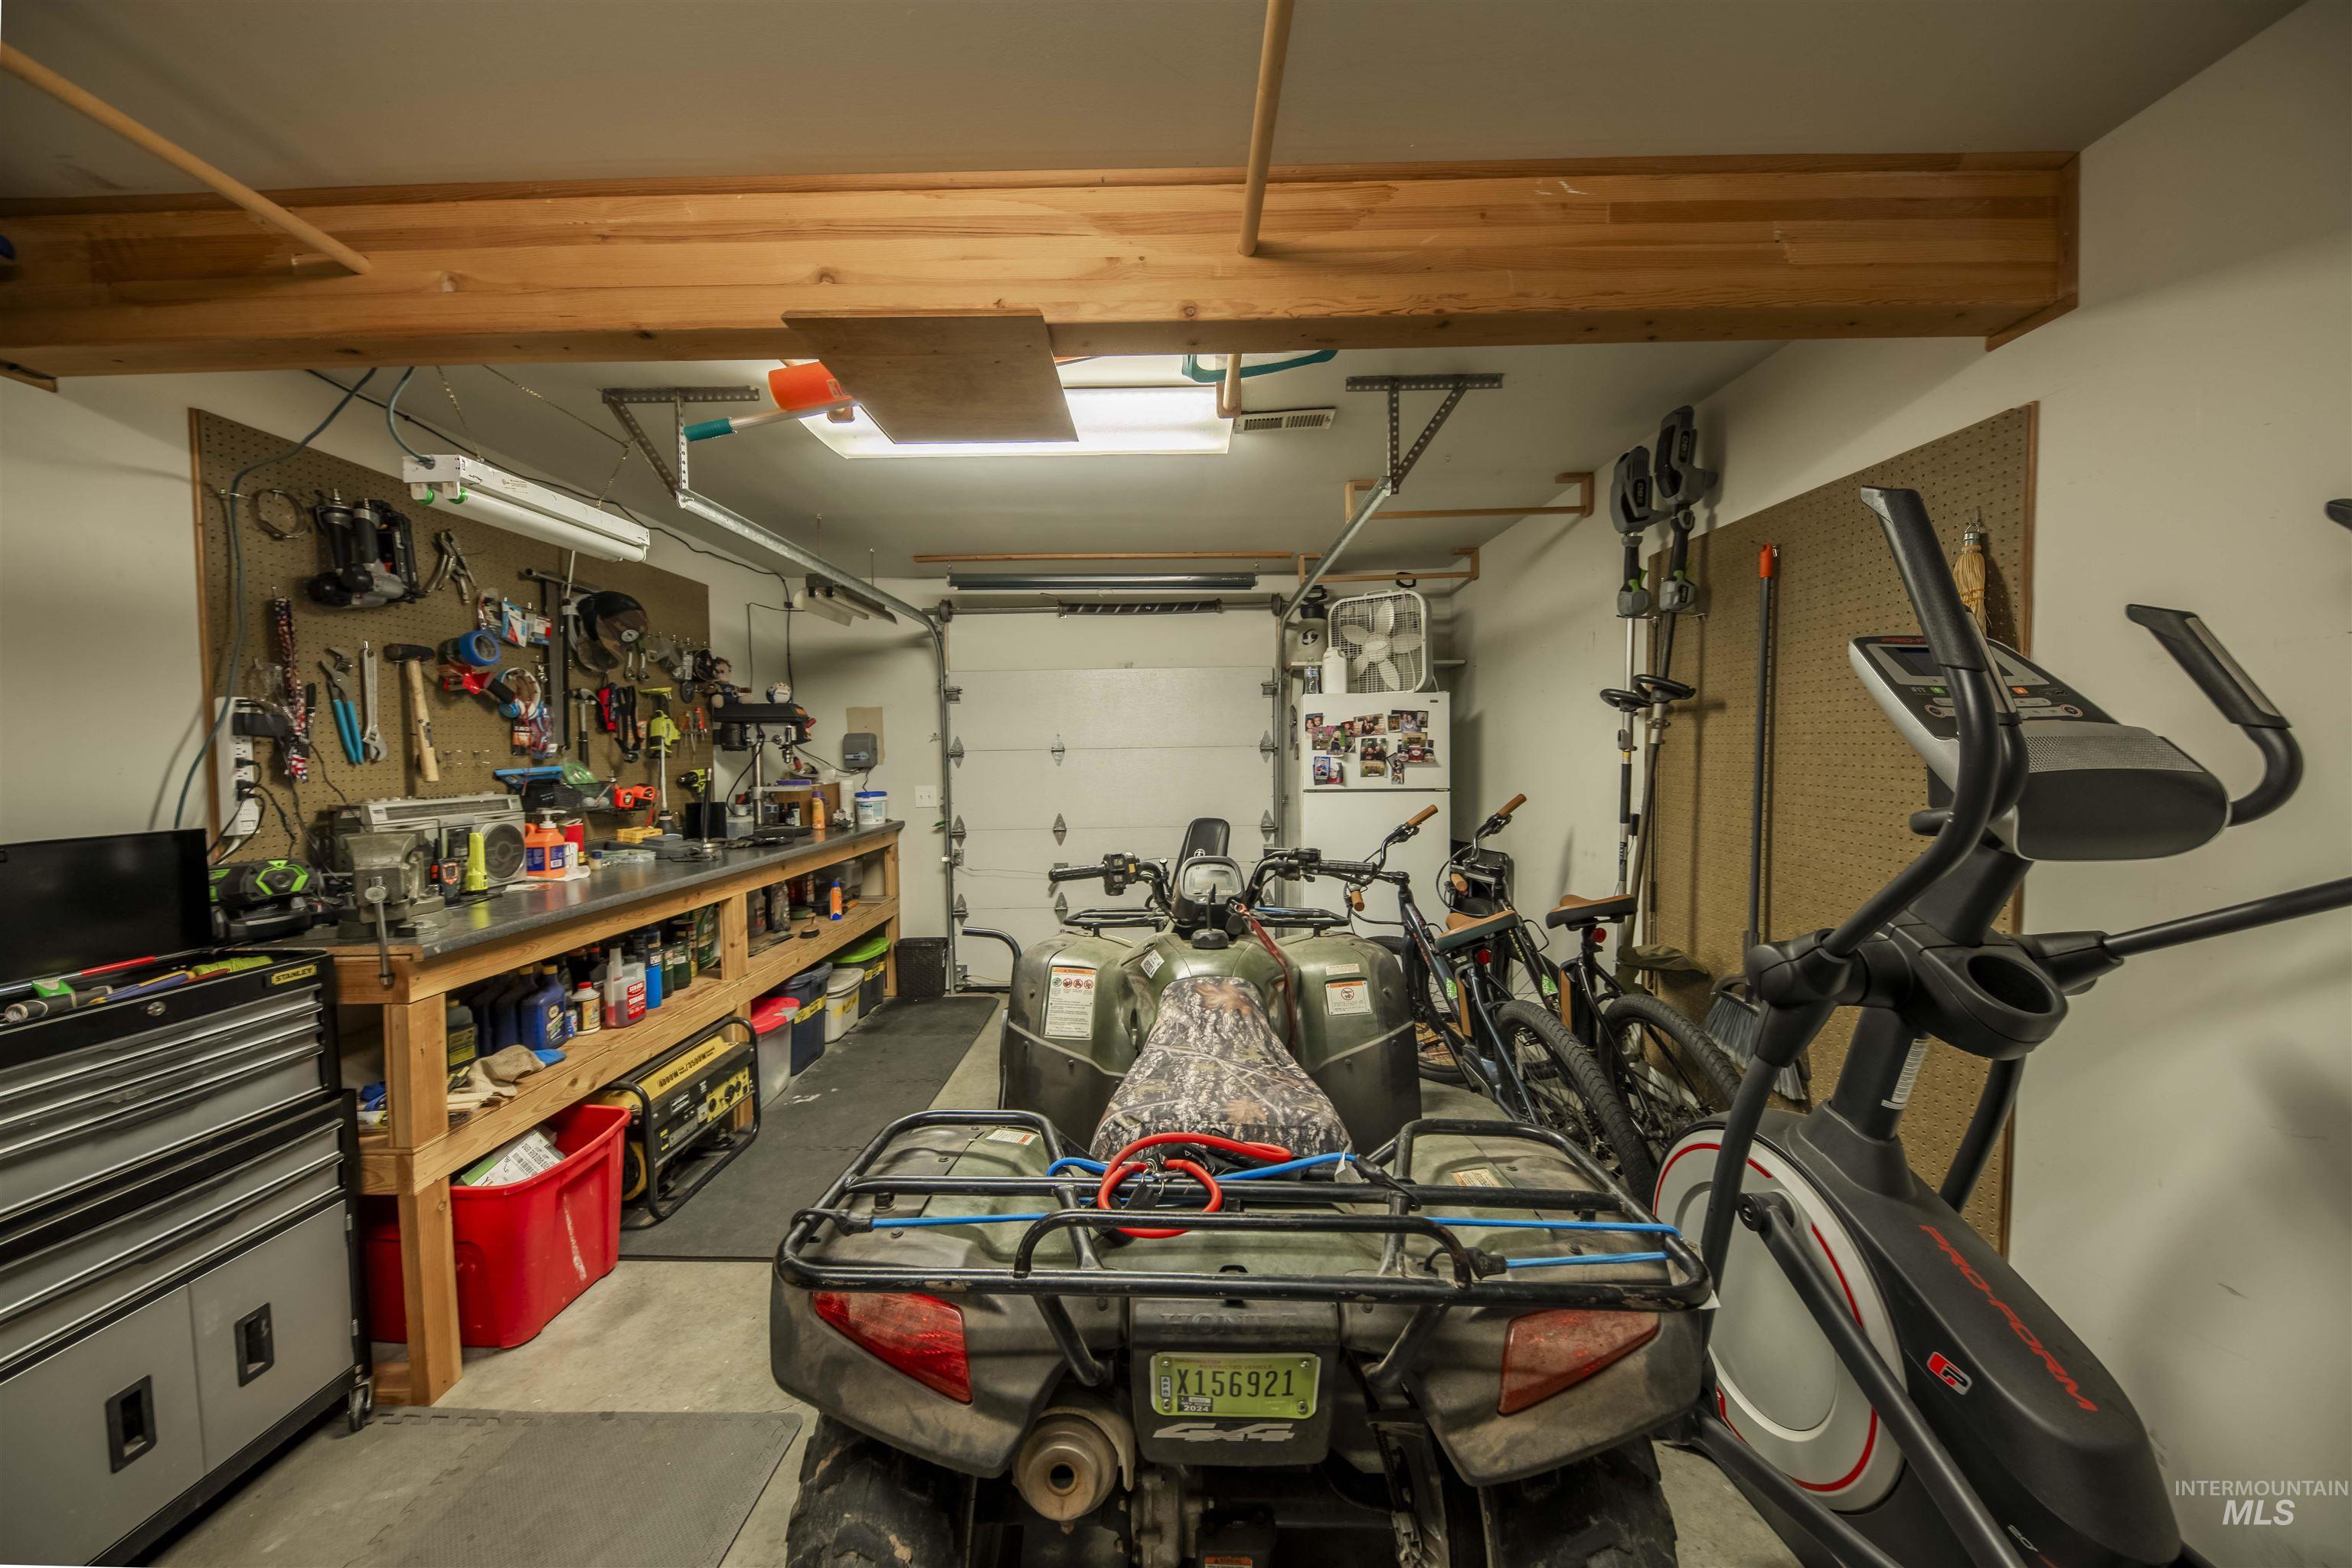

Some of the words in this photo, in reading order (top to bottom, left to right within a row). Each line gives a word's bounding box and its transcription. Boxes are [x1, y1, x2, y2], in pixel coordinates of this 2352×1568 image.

[275, 966, 315, 982] STANLEY
[1160, 1312, 1311, 1335] HONDA
[1919, 1225, 2099, 1412] PRO-FORM
[1177, 1368, 1295, 1398] X156921
